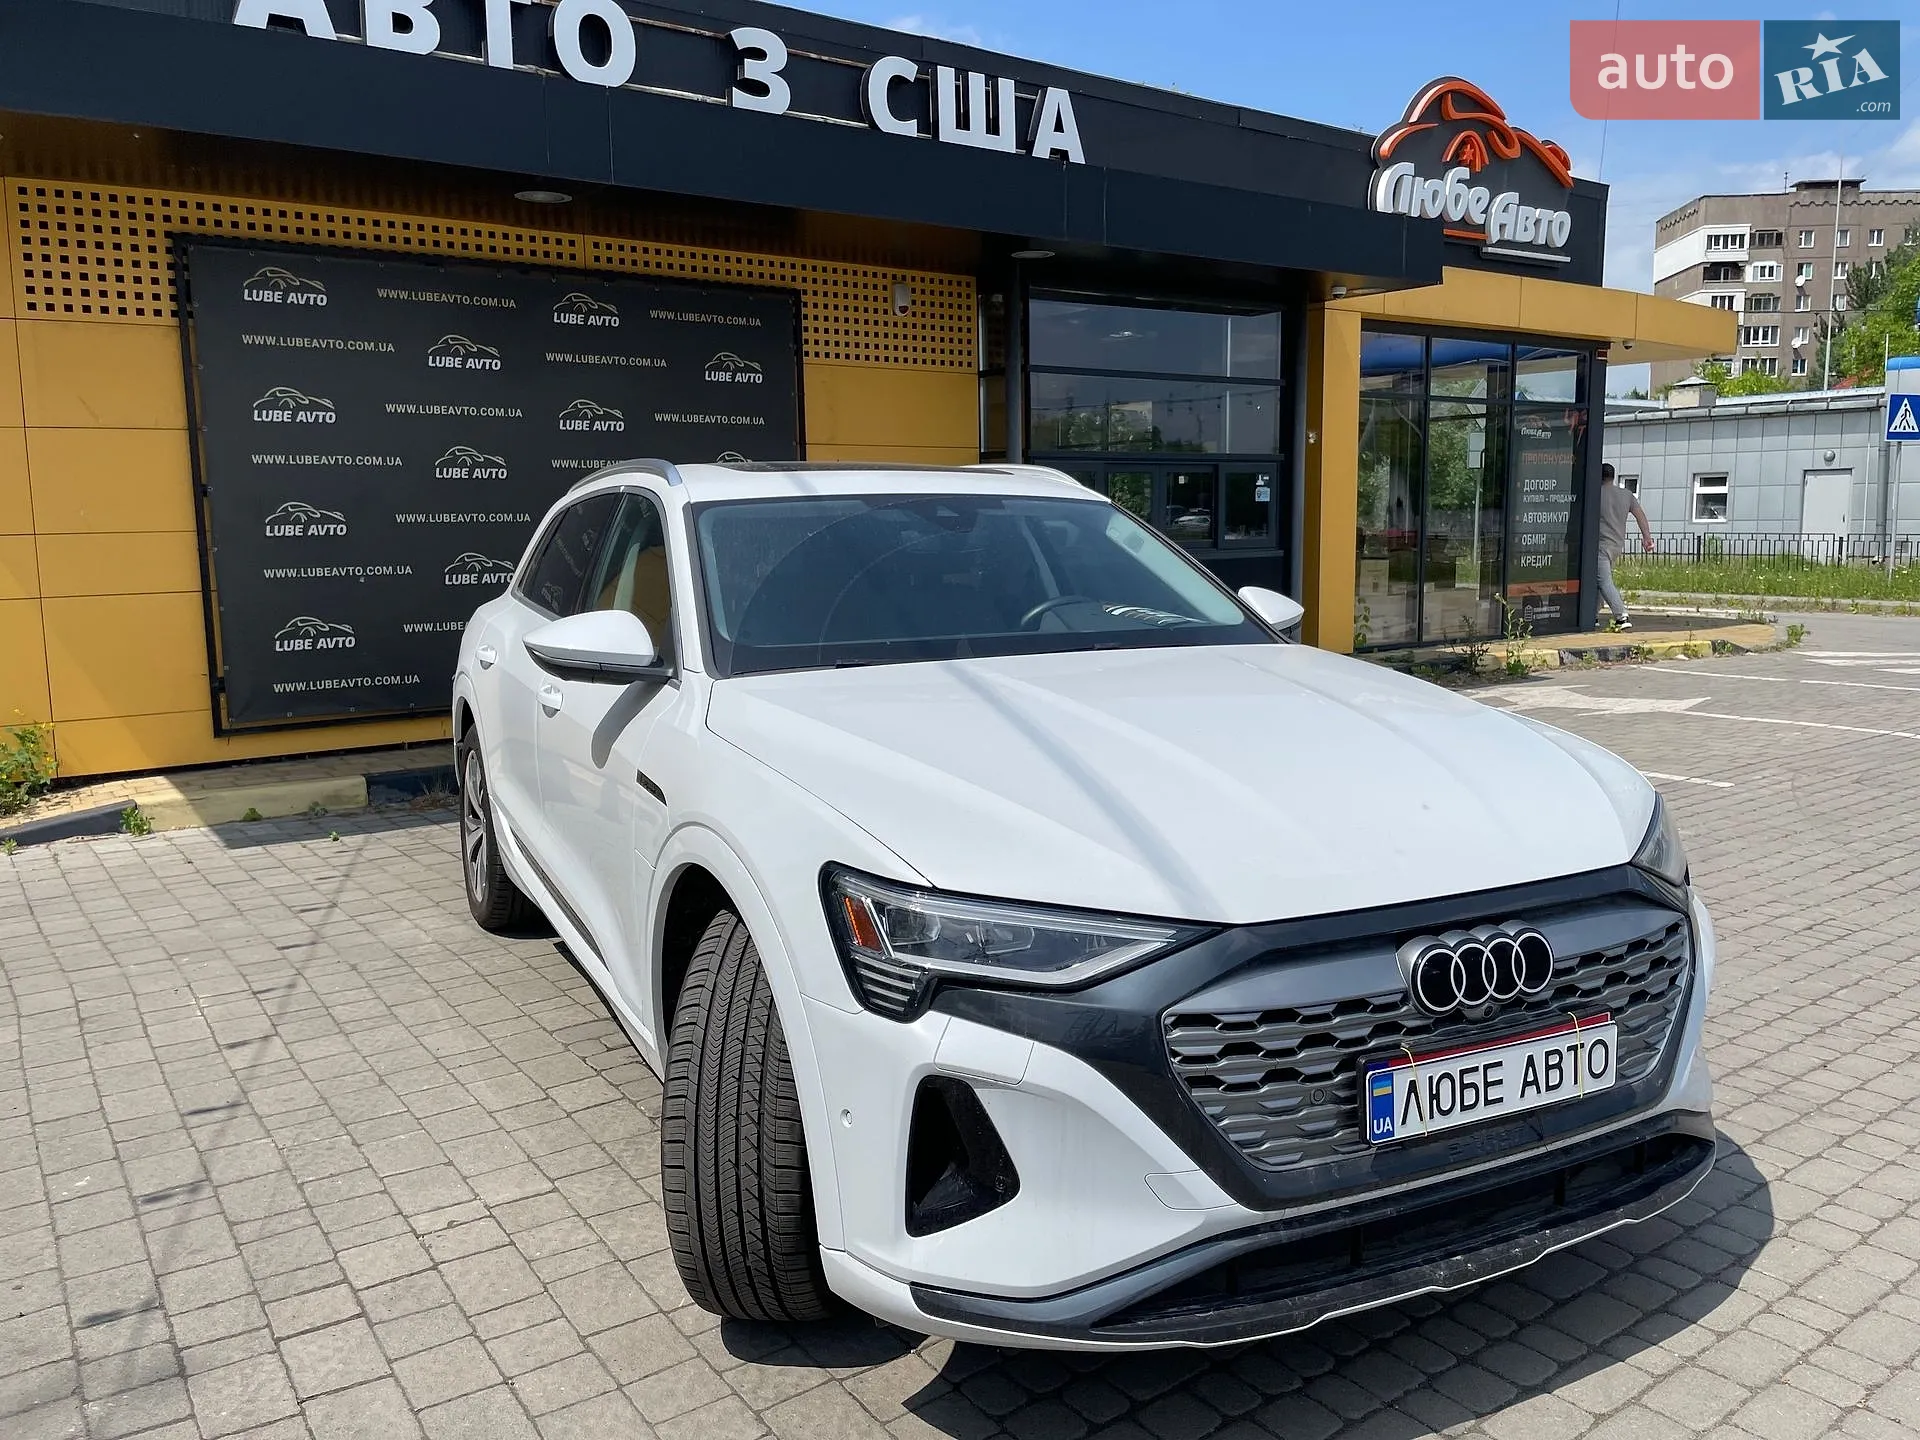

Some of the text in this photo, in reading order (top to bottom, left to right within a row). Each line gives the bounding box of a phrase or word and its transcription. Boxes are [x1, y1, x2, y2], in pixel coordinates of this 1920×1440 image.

[728, 26, 792, 115] З
[867, 55, 1086, 165] США
[243, 289, 328, 306] LUBE AVTO
[377, 287, 517, 309] WWW.LUBEAVTO.COM.UA
[553, 312, 620, 328] LUBE AVTO
[649, 309, 762, 327] WWW.LUBEAVTO.COM.UA
[241, 334, 395, 353] WWW.LUBEAVTO.COM.UA
[428, 355, 501, 371] LUBE AVTO
[545, 352, 668, 369] WWW.LUBEAVTO.COM.UA
[705, 371, 763, 384] LUBE AVTO
[253, 410, 336, 424] LUBE AVTO
[385, 403, 523, 418] WWW.LUBEAVTO.COM.UA
[559, 418, 625, 432] LUBE AVTO
[654, 412, 765, 426] WWW.LUBEAVTO.COM.UA
[251, 454, 403, 467] WWW.LUBEAVTO.COM.UA
[435, 467, 508, 480] LUBE AVTO
[1523, 479, 1557, 493] ДОГОВІР
[395, 513, 531, 523] WWW.LUBEAVTO.COM.UA
[1522, 511, 1569, 523] АВТОВИКУП
[266, 524, 347, 537] LUBE AVTO
[1521, 533, 1546, 545] ОБМІН
[1520, 554, 1552, 568] КРЕДИТ
[264, 566, 413, 579] WWW.LUBEAVTO.COM.UA
[444, 573, 478, 585] LUBE
[275, 636, 356, 652] LUBE AVTO
[273, 674, 420, 693] WWW.LUBEAVTO.COM.UA
[1400, 1038, 1609, 1126] ЛЮБЕ АВТО
[1374, 1116, 1393, 1135] UA
